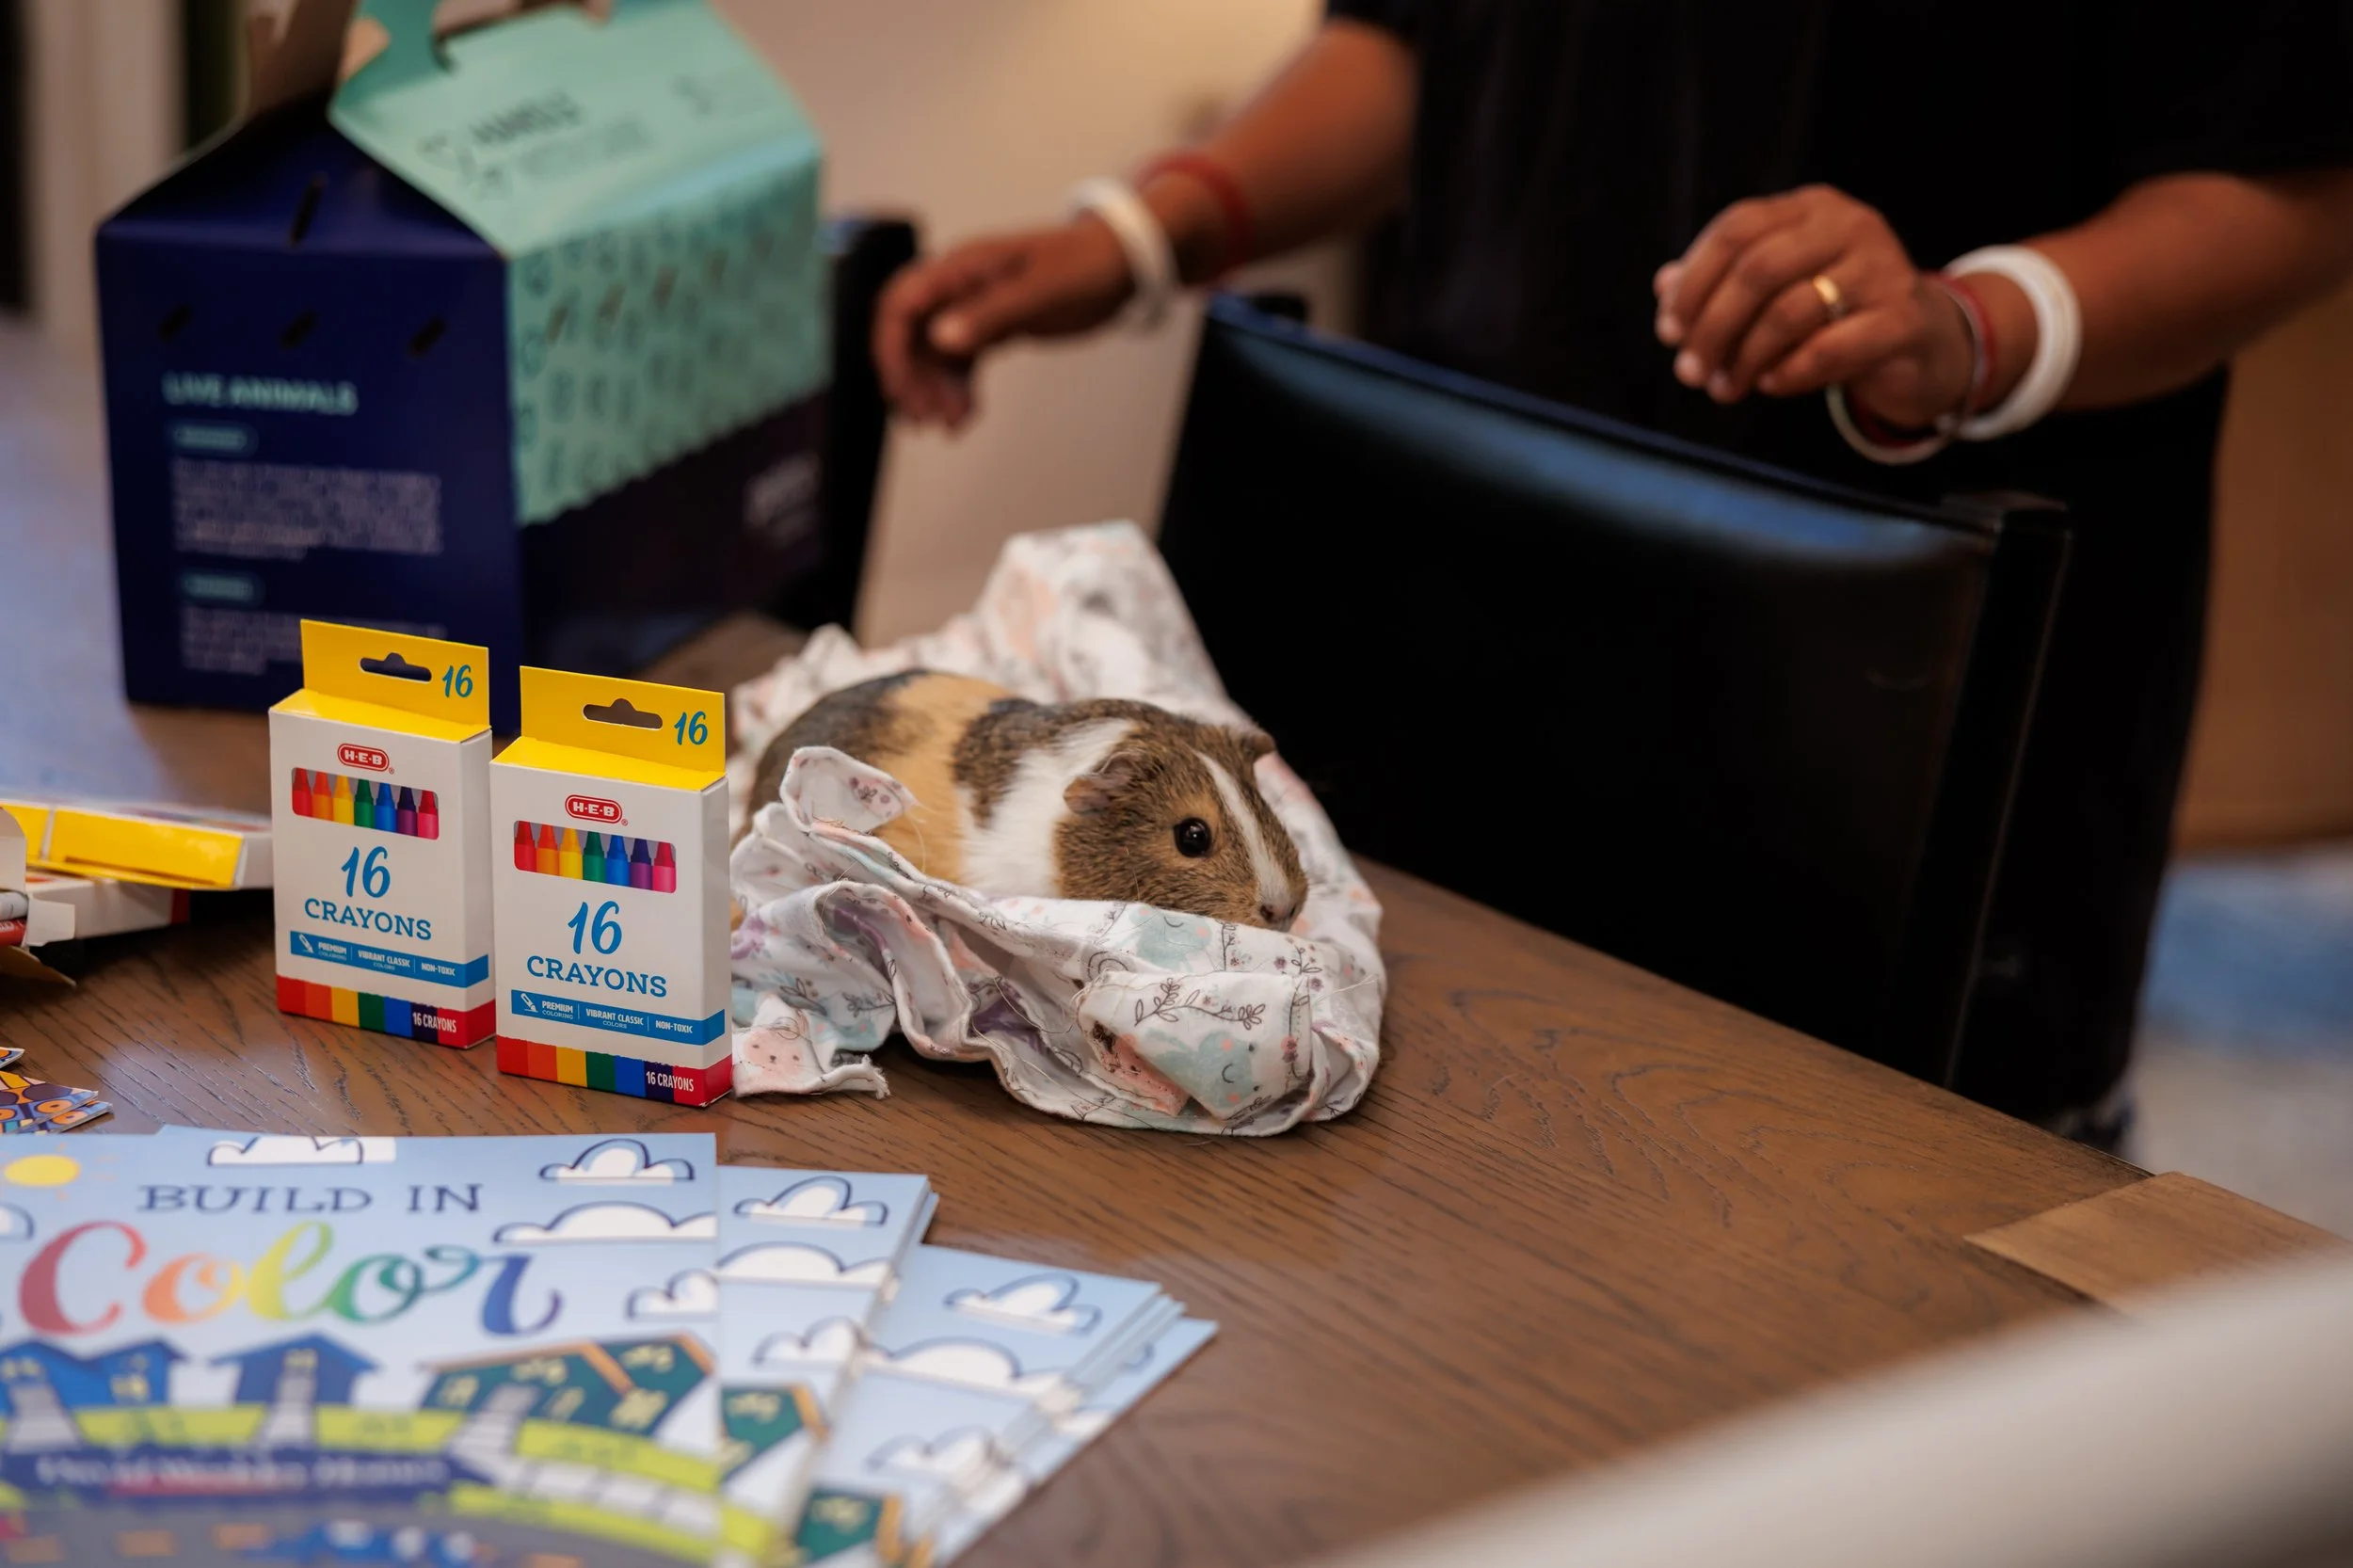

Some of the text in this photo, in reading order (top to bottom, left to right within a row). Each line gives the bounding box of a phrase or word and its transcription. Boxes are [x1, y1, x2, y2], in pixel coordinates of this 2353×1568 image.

[230, 376, 357, 414] ANIMALS
[442, 664, 473, 697] 16
[674, 711, 708, 745] 16
[341, 846, 391, 898] 16
[304, 898, 432, 940] CRAYONS
[568, 901, 622, 954] 16
[318, 942, 347, 954] PREMIUM
[358, 951, 410, 968] VIBRANT CLASSIC
[422, 963, 456, 976] NON-TOXIC
[527, 955, 667, 998] CRAYONS
[542, 1000, 573, 1014] PREMIUM
[542, 1010, 573, 1019] COLORING
[586, 1008, 644, 1026] VIBRANT CLASSIC
[412, 1012, 456, 1033] 16 CRAYONS
[603, 1020, 628, 1029] COLORS
[655, 1020, 693, 1033] NON-TOXIC
[646, 1071, 694, 1092] 16 CRAYONS
[137, 1184, 483, 1214] BUILD IN
[18, 1221, 562, 1336] Color
